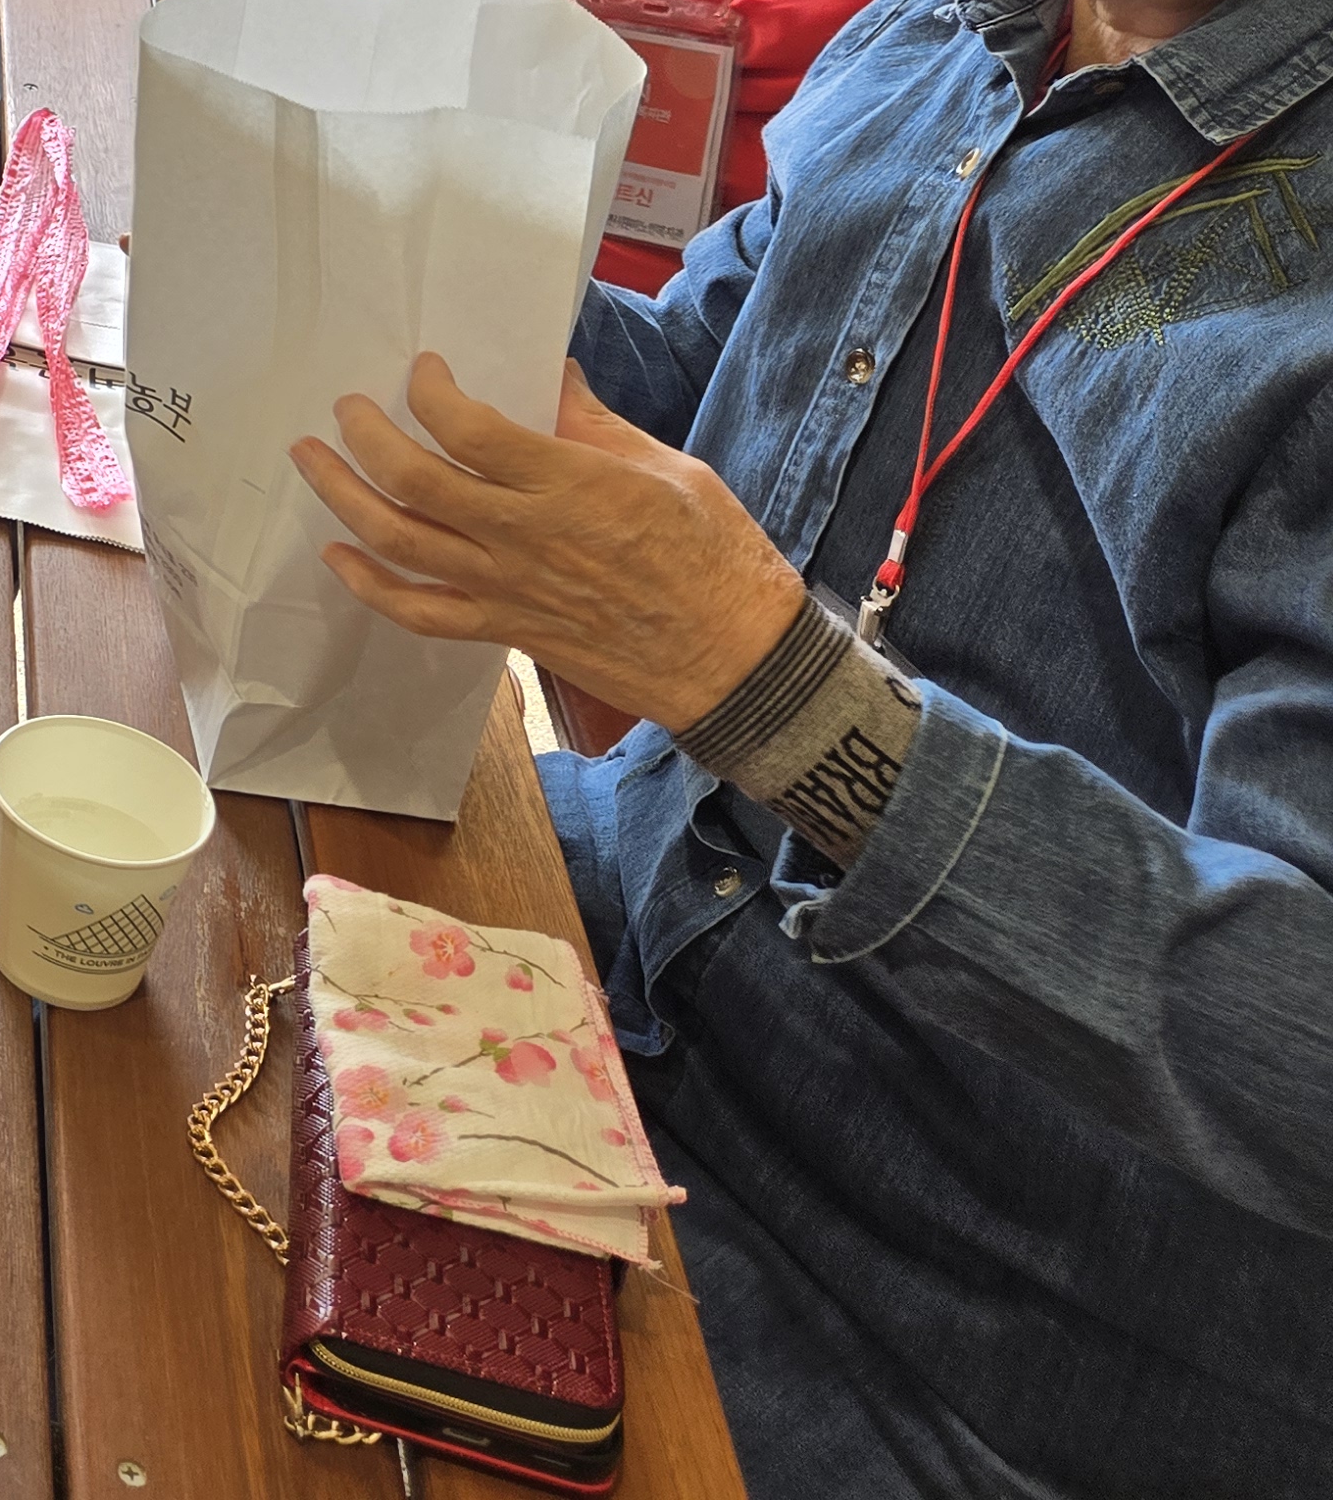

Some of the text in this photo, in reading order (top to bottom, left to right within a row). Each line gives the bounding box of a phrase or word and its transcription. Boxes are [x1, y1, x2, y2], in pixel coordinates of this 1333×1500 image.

[616, 183, 654, 208] 르신
[126, 370, 193, 429] 농부
[54, 948, 78, 963] THE
